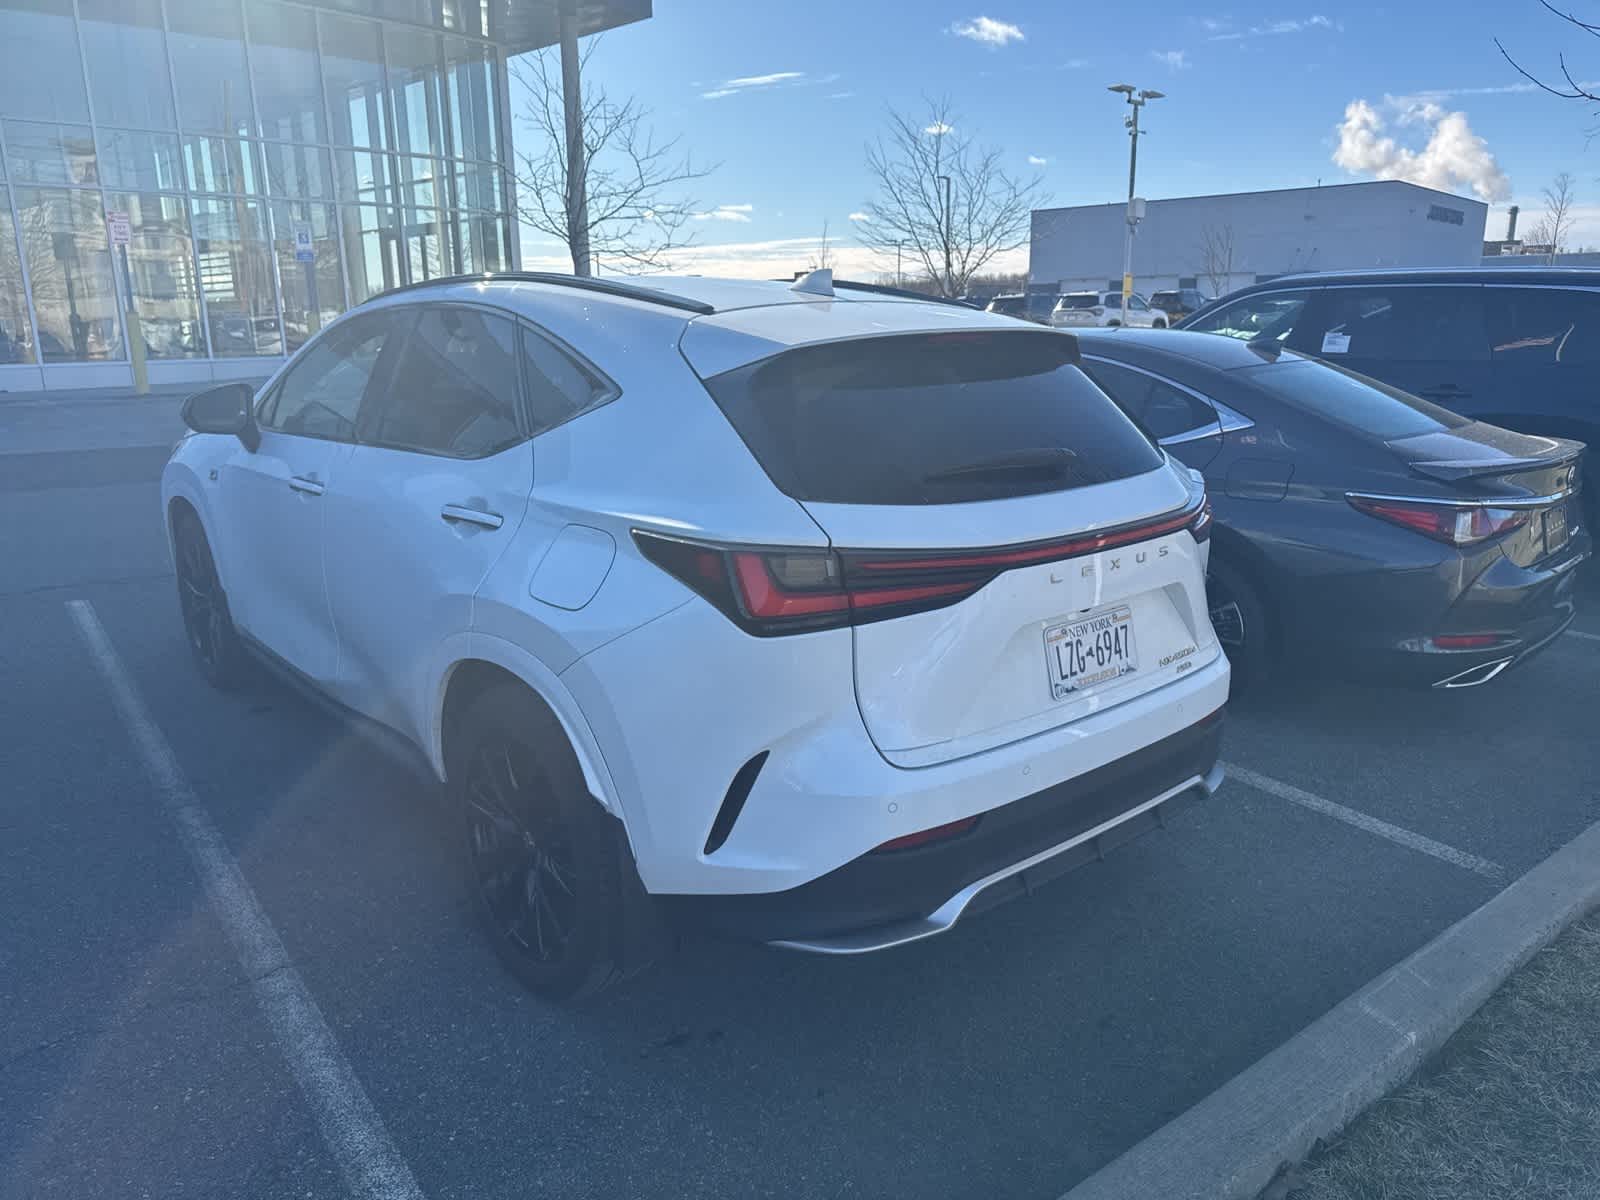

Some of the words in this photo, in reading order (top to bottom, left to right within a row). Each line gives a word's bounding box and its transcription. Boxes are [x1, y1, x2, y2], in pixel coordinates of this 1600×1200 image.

[1050, 545, 1169, 584] LEXUS
[1068, 622, 1089, 639] NEW
[1089, 616, 1113, 633] YORK
[1056, 638, 1086, 681] LZG
[1095, 624, 1129, 667] 6947
